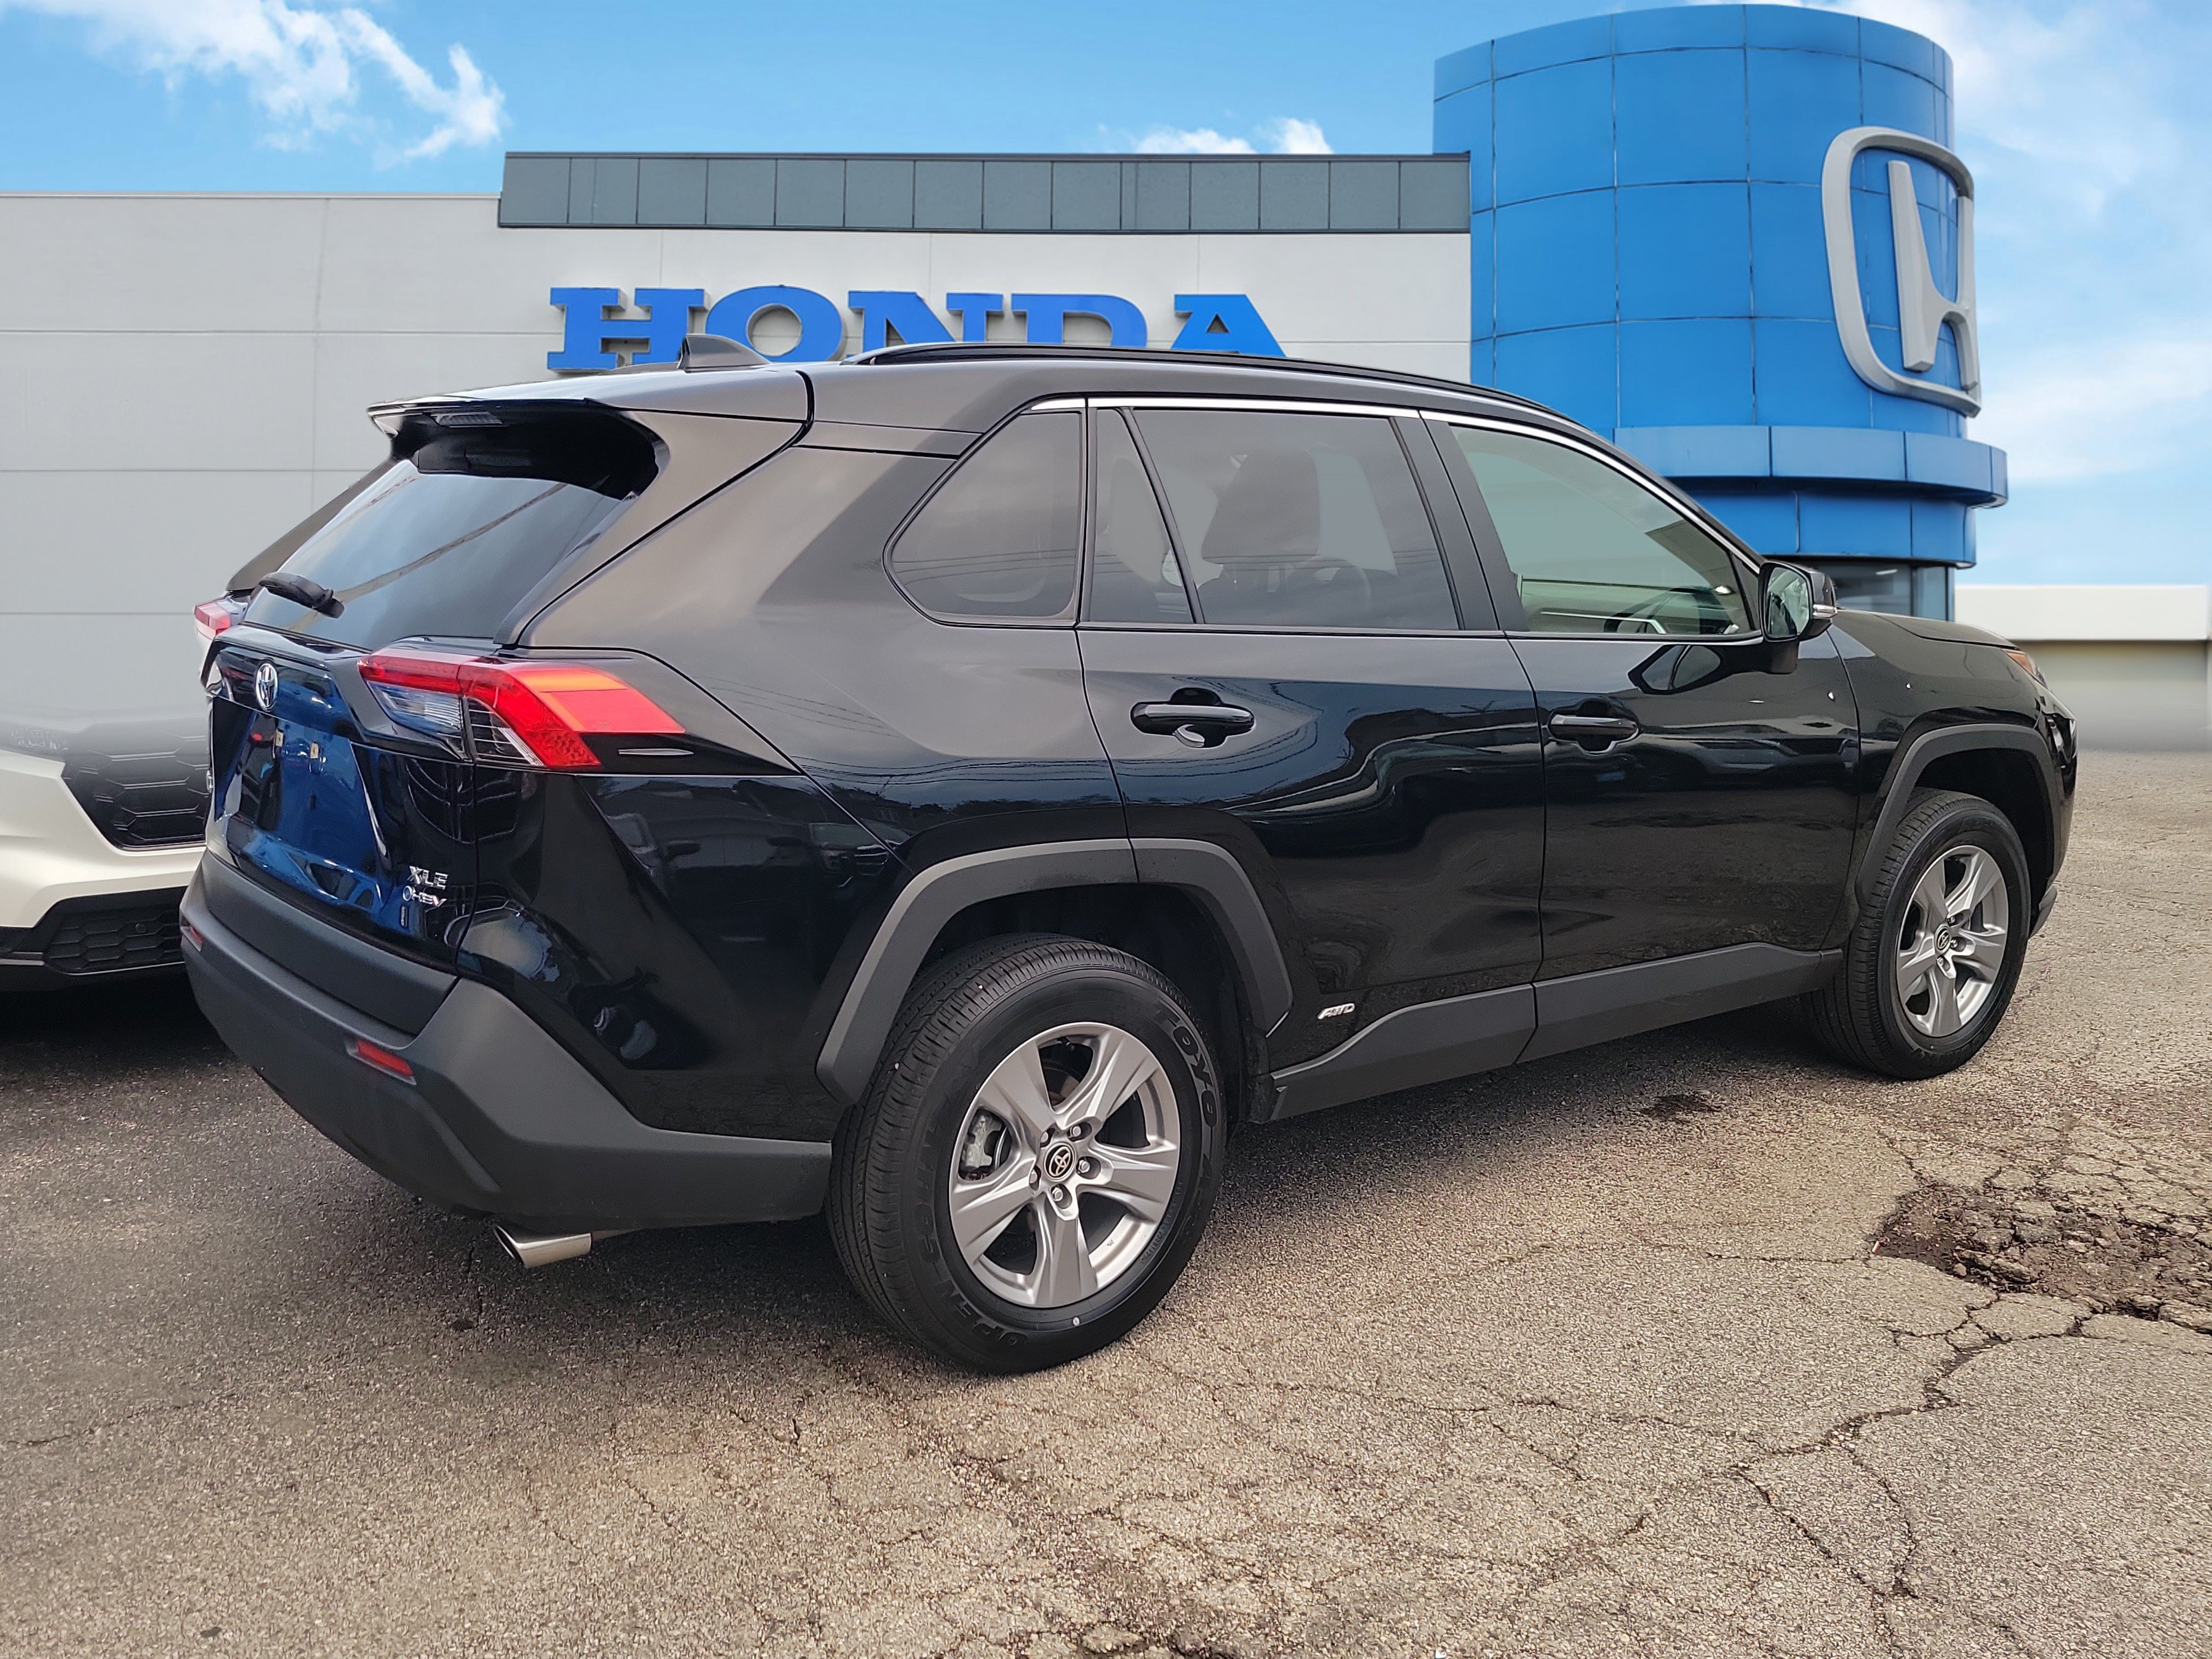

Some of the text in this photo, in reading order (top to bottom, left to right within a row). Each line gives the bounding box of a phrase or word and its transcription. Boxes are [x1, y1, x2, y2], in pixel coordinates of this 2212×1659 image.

[547, 285, 1289, 371] HONDA
[407, 866, 448, 890] XLE
[1150, 1002, 1218, 1128] TOYO
